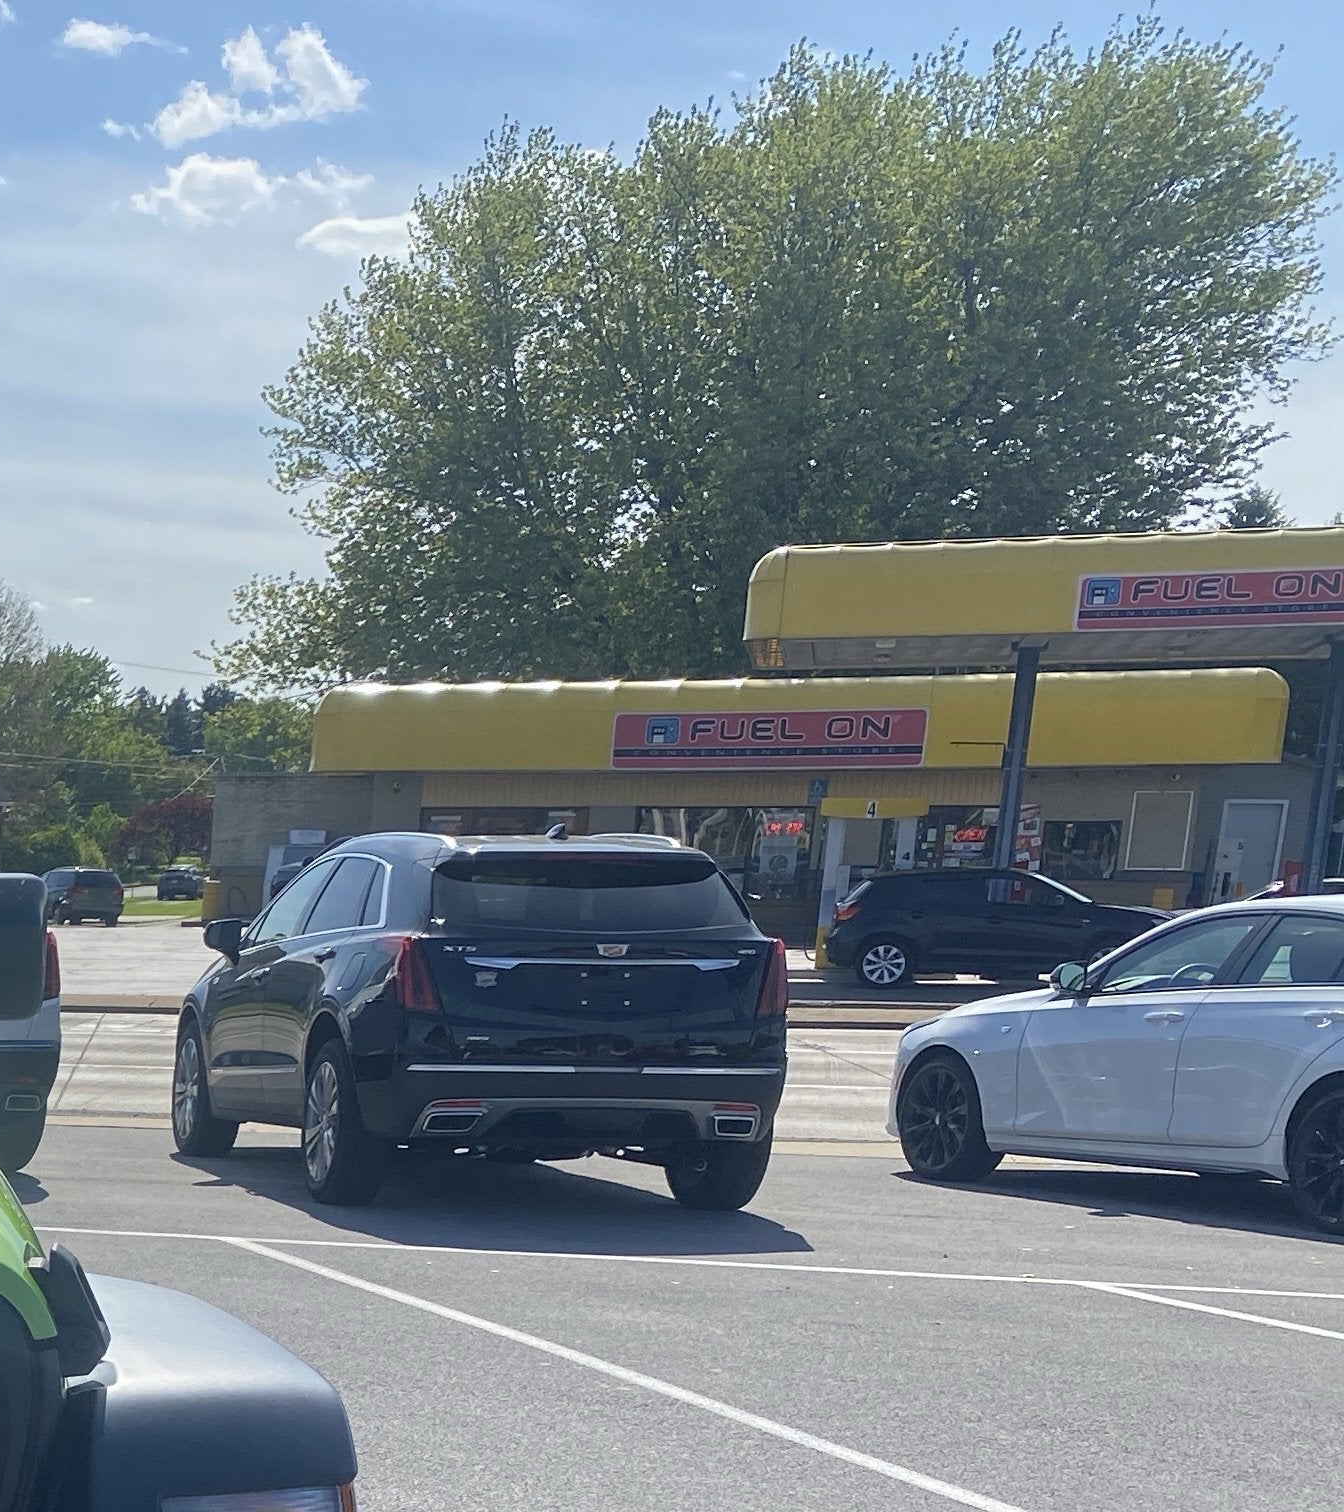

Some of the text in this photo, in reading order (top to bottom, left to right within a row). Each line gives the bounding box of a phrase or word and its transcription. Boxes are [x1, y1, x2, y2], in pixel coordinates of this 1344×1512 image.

[1131, 571, 1342, 602] FUEL ON
[1095, 603, 1330, 617] CONVENIENCE STORE
[689, 715, 892, 742] FUEL ON
[633, 746, 896, 757] CONVENIENCE STORE
[868, 801, 876, 818] 4
[902, 852, 911, 861] 4
